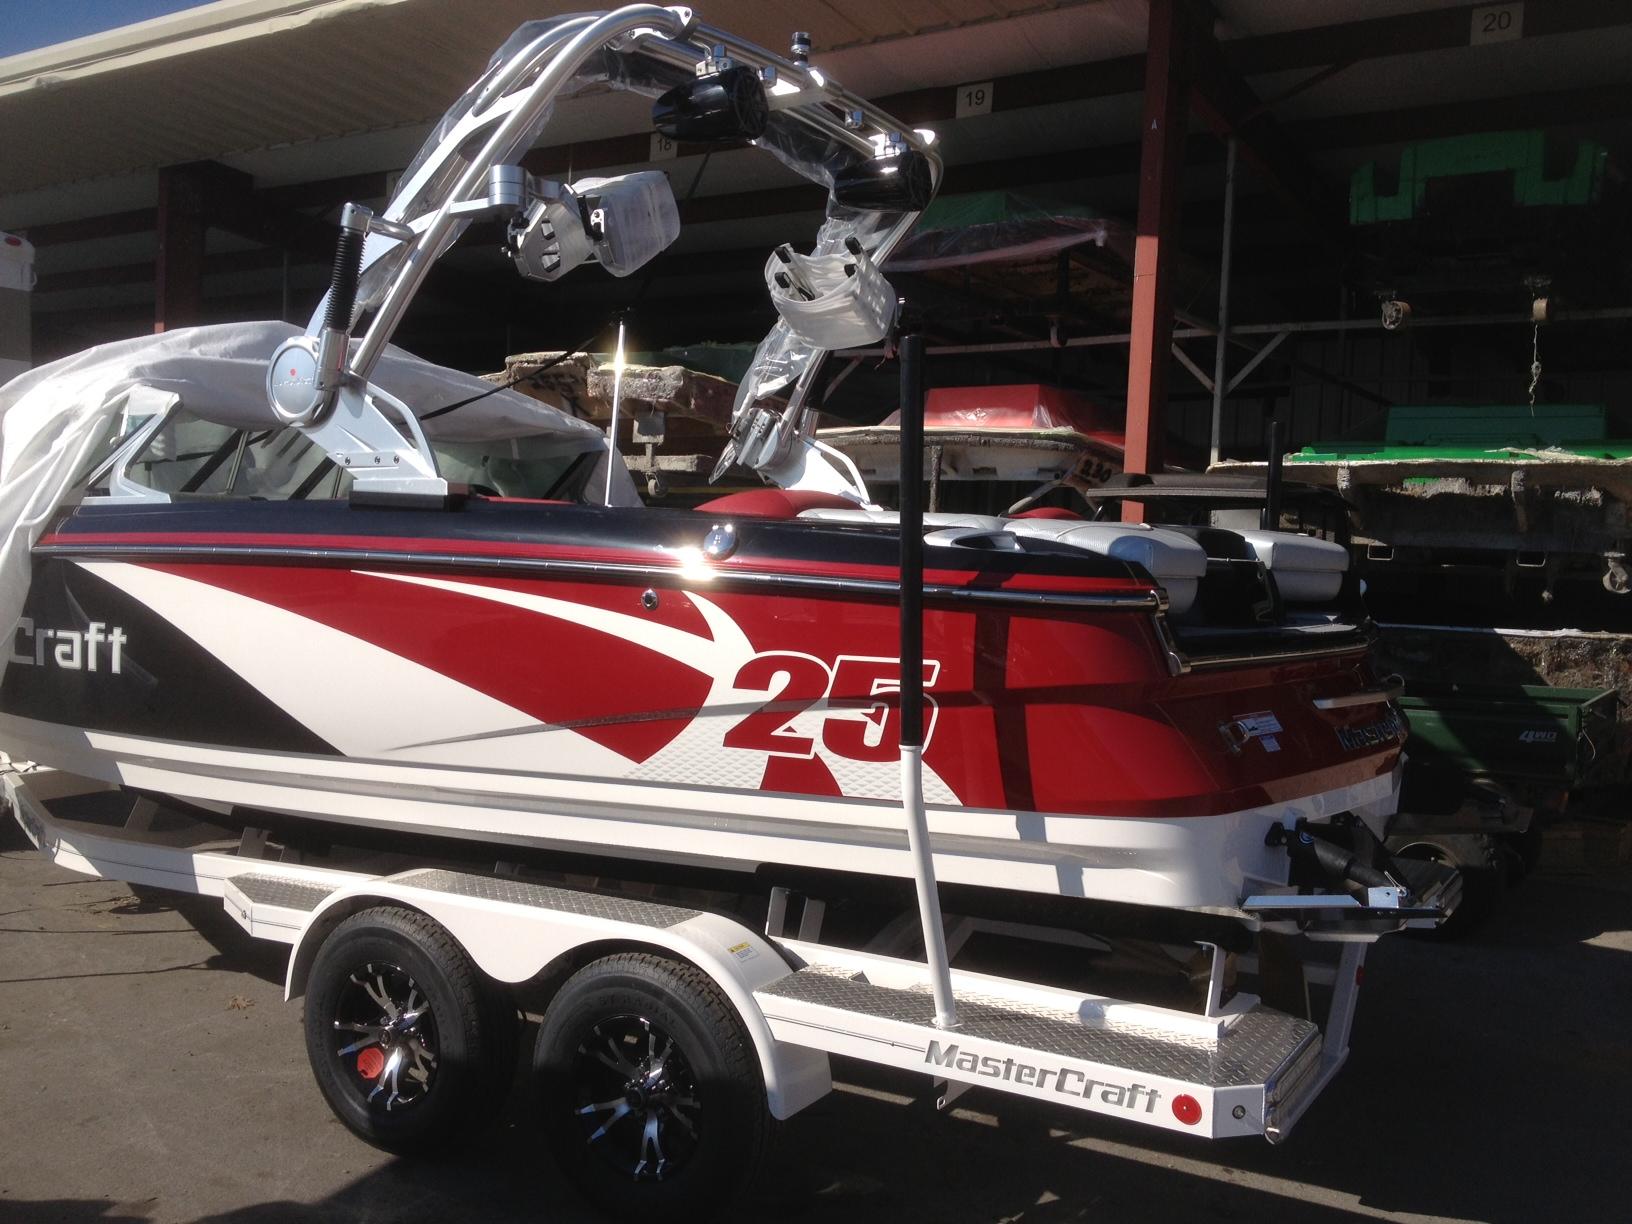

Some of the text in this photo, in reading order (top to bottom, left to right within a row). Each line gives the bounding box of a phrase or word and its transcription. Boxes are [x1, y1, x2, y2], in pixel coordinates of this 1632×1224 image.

[1482, 11, 1511, 32] 20
[966, 89, 985, 107] 19
[723, 650, 941, 763] 25
[924, 1039, 1162, 1114] MasterCraft
